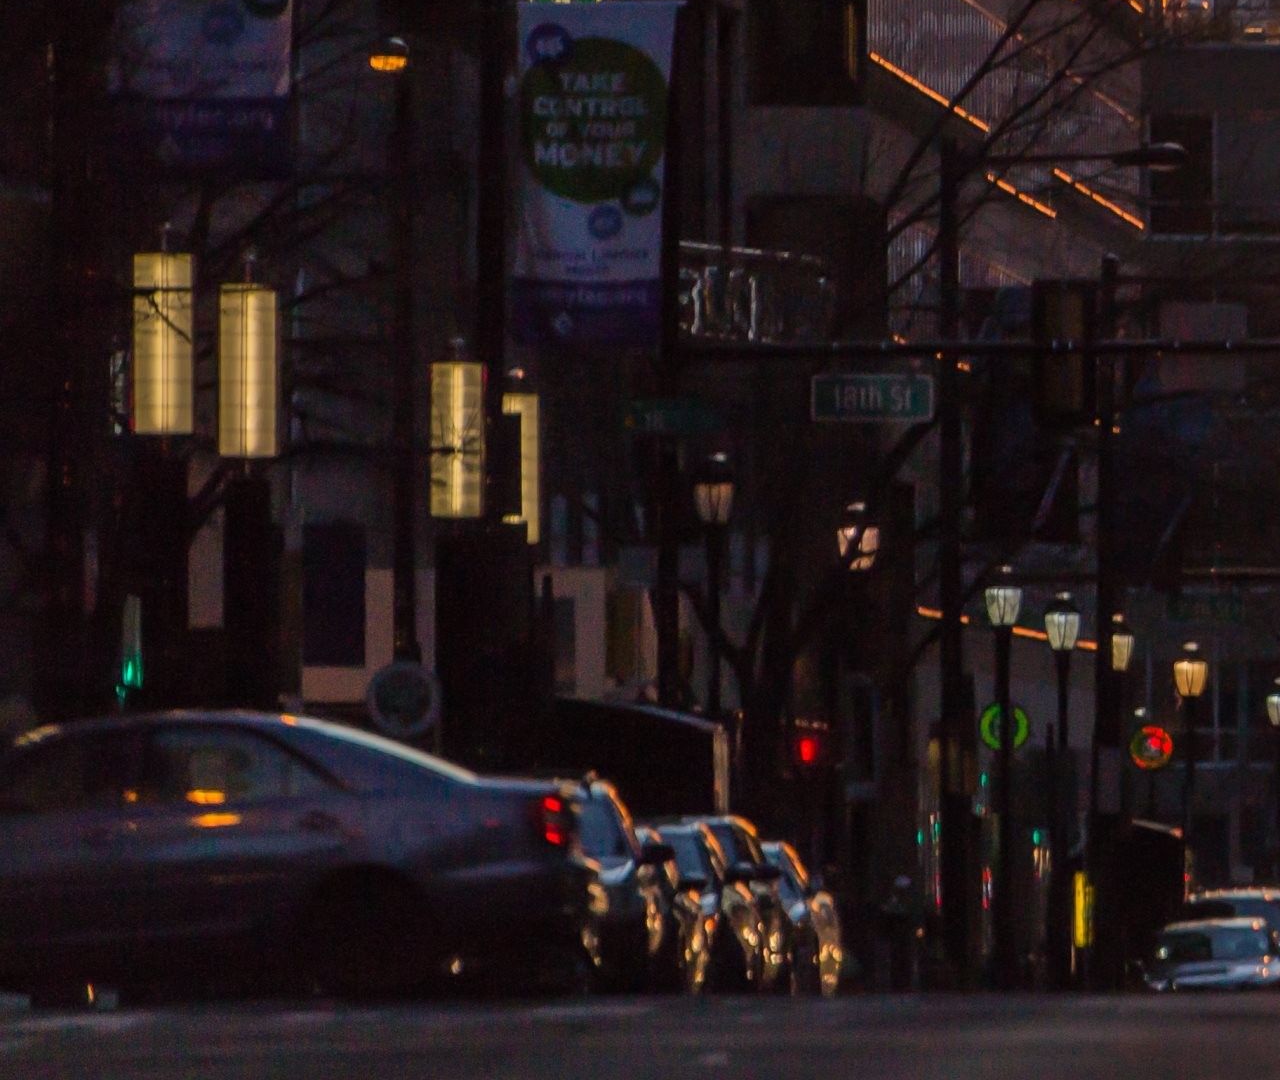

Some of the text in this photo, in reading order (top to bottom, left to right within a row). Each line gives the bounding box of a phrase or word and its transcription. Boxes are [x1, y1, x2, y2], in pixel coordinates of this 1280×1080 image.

[559, 71, 626, 94] TAKE
[533, 95, 649, 118] CONTROL
[546, 120, 570, 139] OF
[534, 139, 647, 168] MONEY
[833, 383, 912, 410] 18th St
